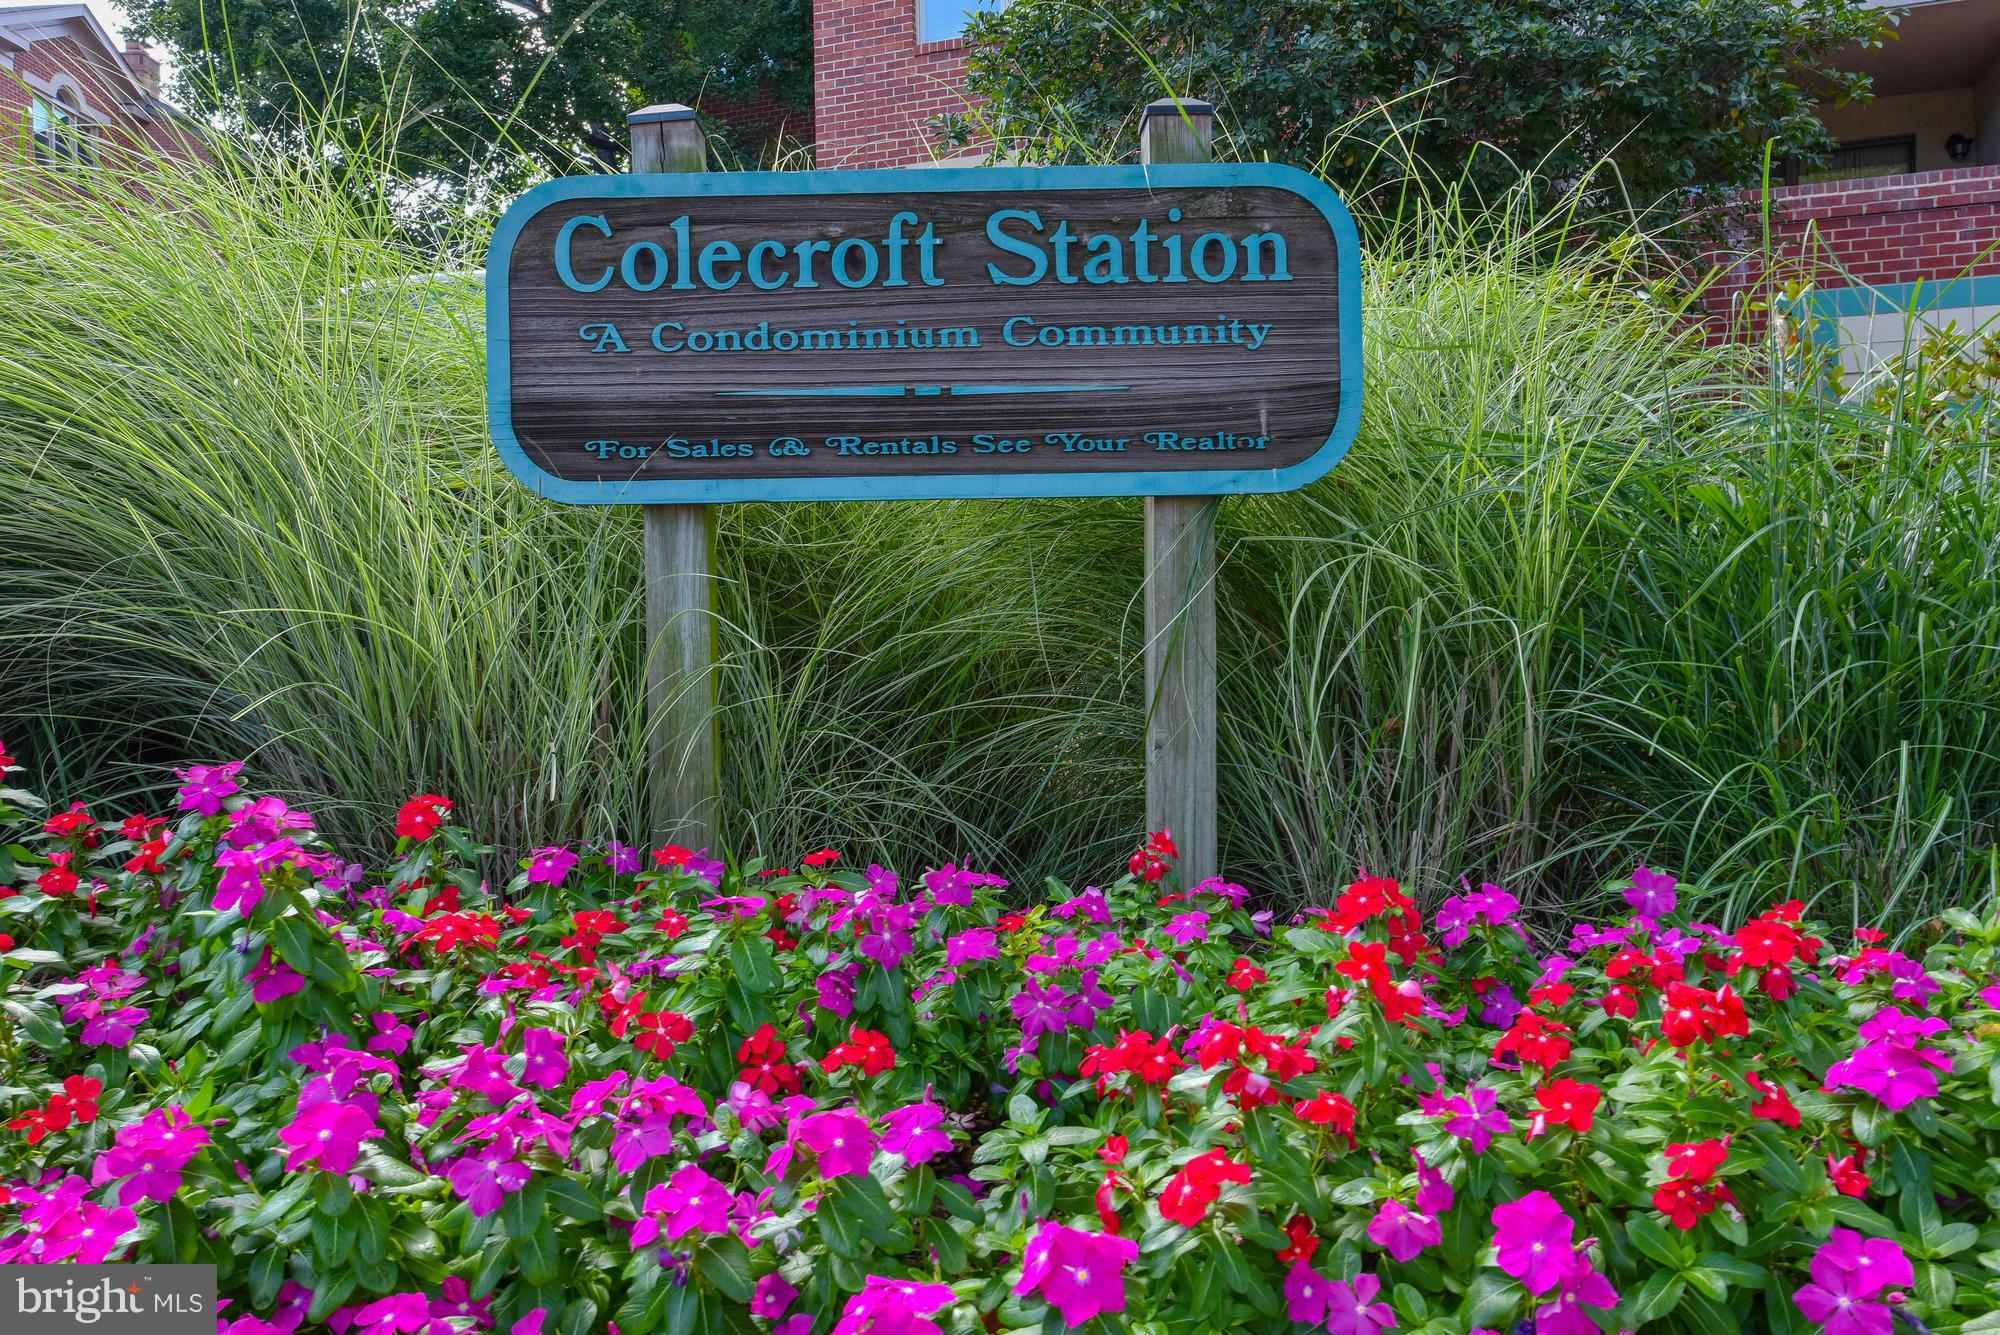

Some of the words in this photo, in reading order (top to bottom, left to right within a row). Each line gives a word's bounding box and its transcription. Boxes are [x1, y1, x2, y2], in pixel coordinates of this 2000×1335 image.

[554, 211, 945, 293] Colecroft
[986, 208, 1295, 286] Station
[579, 322, 630, 352] A
[651, 319, 980, 352] Condominium
[1003, 314, 1272, 351] Community
[584, 439, 651, 459] For
[667, 438, 753, 458] Sales
[769, 436, 811, 456] &
[825, 435, 957, 456] Rentals
[972, 434, 1031, 454] See
[1045, 432, 1130, 452] Your
